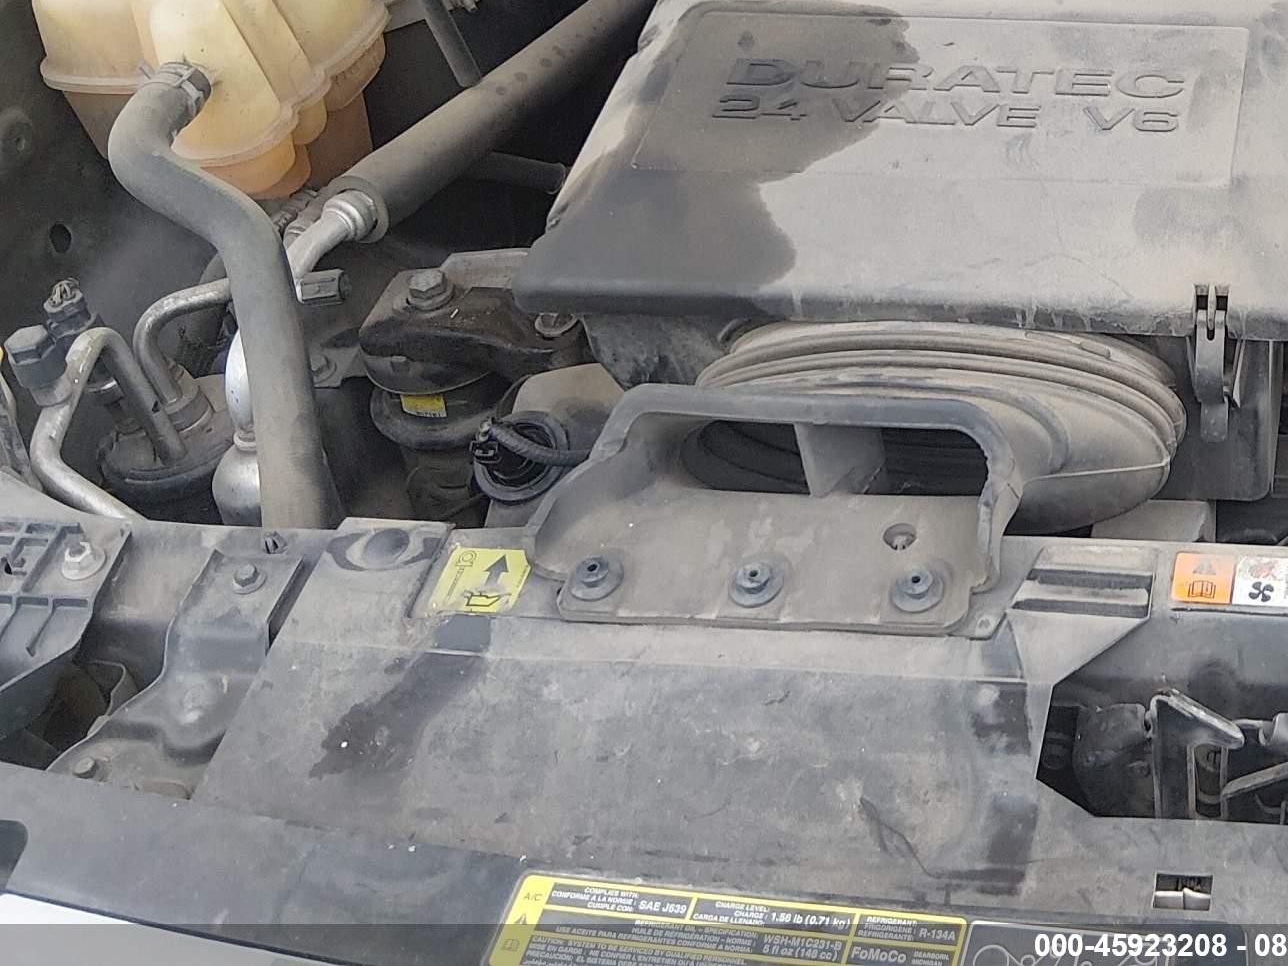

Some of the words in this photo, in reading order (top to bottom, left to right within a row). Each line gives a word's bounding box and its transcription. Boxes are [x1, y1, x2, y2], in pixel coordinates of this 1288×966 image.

[726, 57, 1185, 98] DURATEC
[711, 93, 807, 121] 24
[831, 98, 1043, 129] VALVE
[1082, 105, 1180, 133] V6
[523, 893, 543, 902] A/C
[638, 900, 660, 911] SAE
[661, 902, 687, 914] J639
[715, 901, 745, 910] CHARGE
[793, 914, 803, 924] lb
[805, 914, 830, 926] (0.71
[833, 917, 851, 930] kg)
[919, 927, 956, 941] R-134A
[851, 946, 907, 963] FoMoCo
